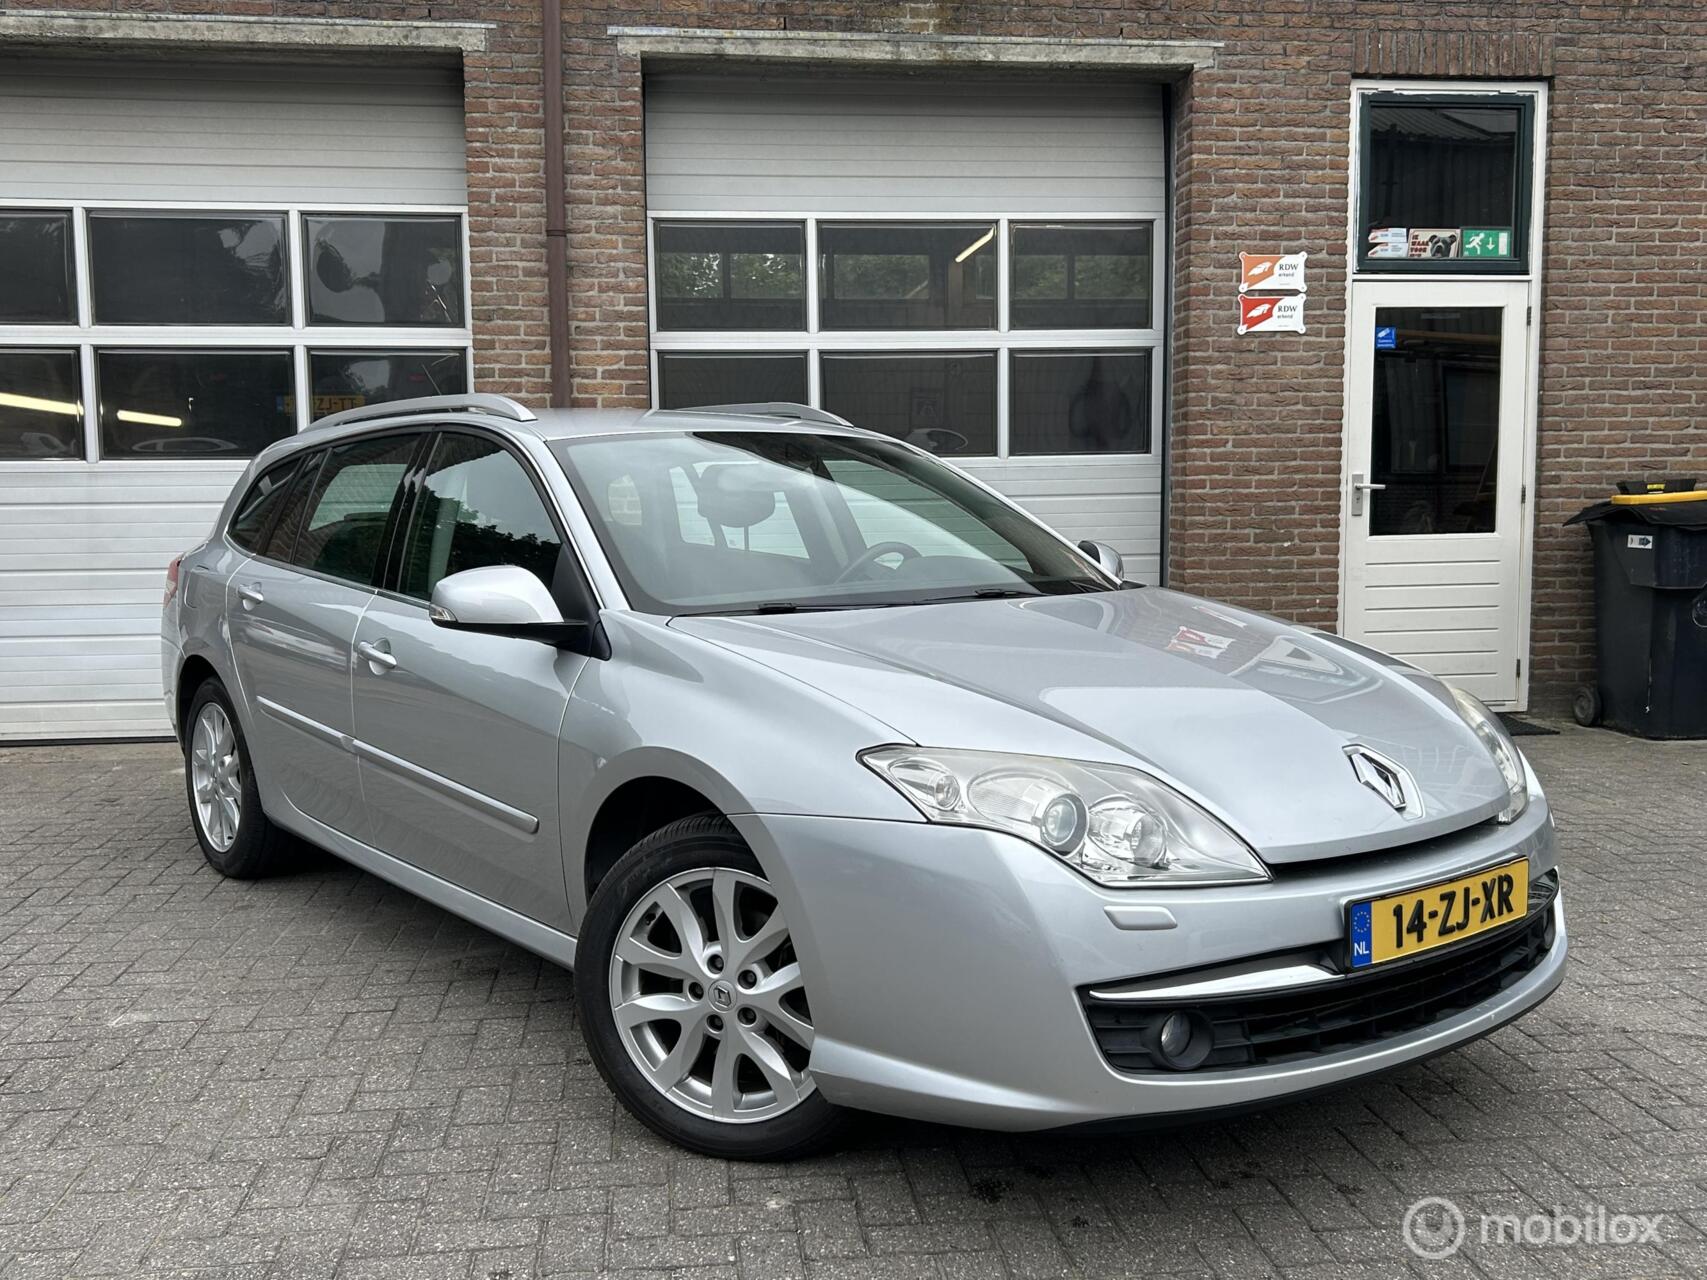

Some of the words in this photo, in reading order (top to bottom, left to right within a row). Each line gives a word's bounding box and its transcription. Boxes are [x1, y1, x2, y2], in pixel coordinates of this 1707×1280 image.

[1279, 263, 1299, 271] RDW
[1277, 304, 1298, 312] RDW
[1392, 873, 1515, 949] 14-ZJ-XR
[1354, 942, 1370, 956] NL
